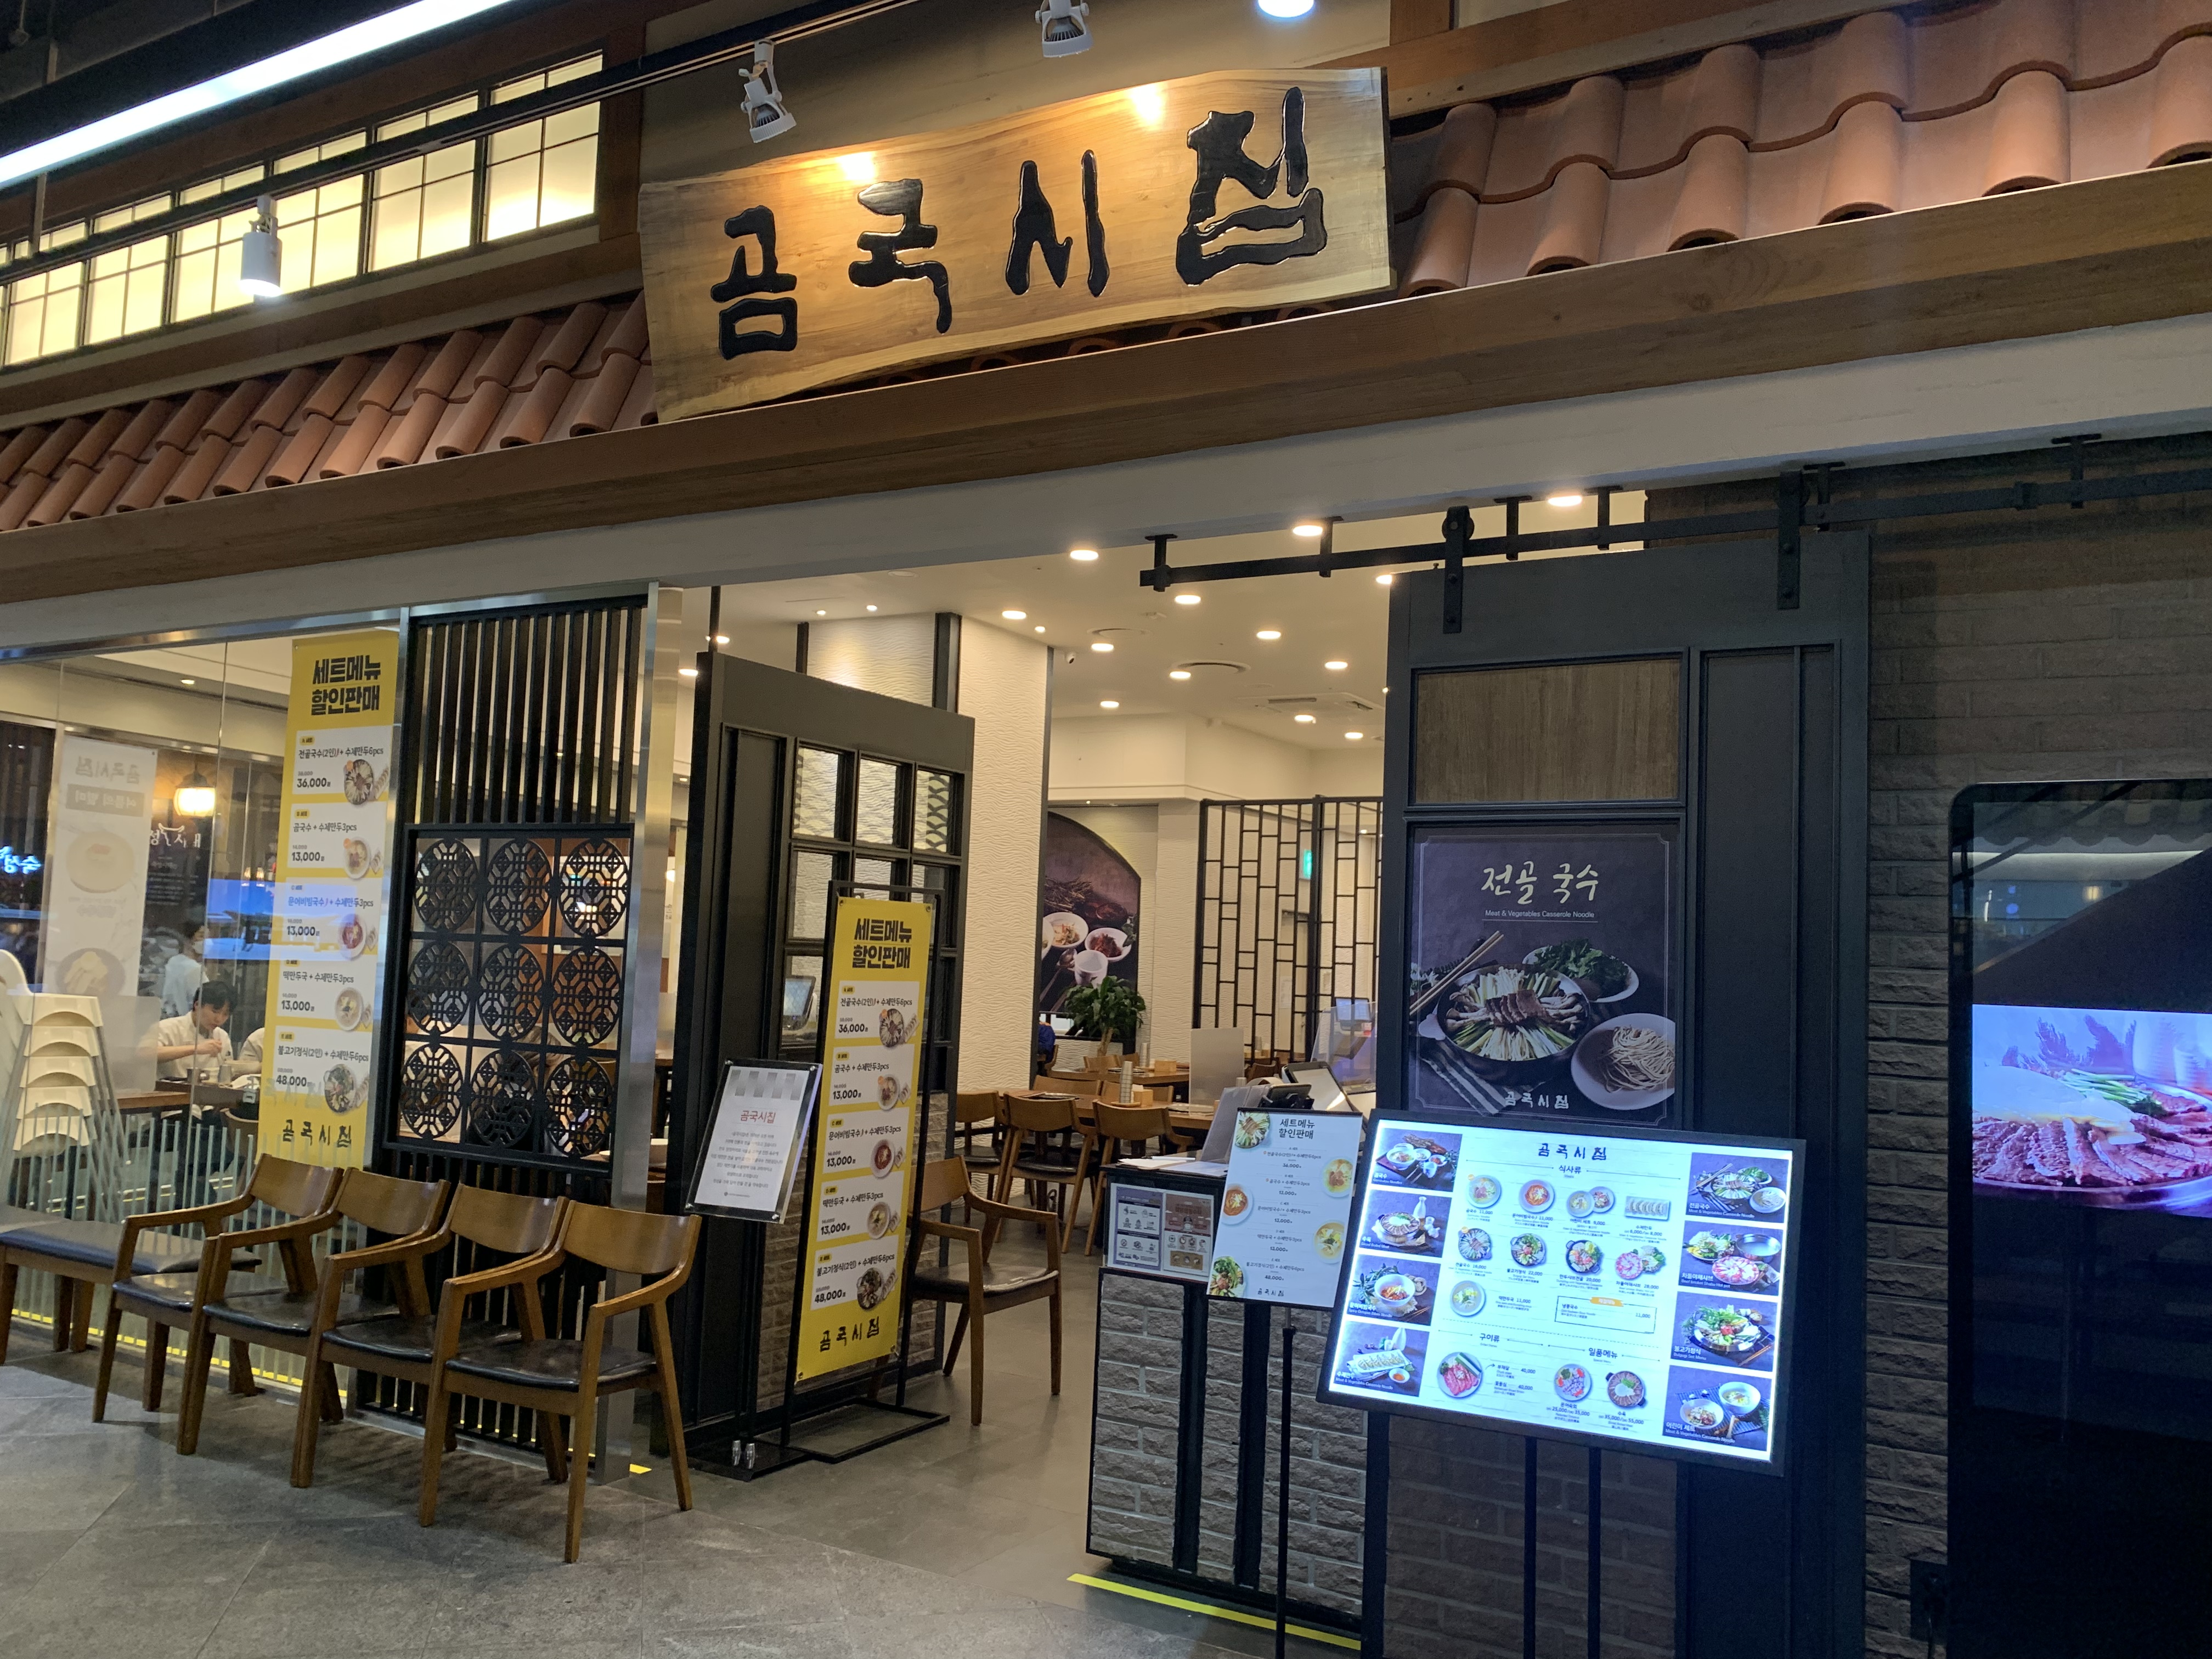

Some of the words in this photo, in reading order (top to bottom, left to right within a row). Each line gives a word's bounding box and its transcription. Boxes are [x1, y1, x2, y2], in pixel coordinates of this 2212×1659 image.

[710, 86, 1328, 361] 곰국시집
[313, 655, 381, 684] 세트메뉴
[311, 685, 380, 715] 할인판매
[293, 823, 312, 832] 곰국수
[1481, 861, 1537, 904] 전골
[1553, 861, 1599, 903] 국수
[854, 918, 912, 943] 세트메뉴
[852, 945, 911, 969] 할인판매
[1505, 1092, 1568, 1109] 곰국시집
[741, 1110, 775, 1124] 곰국시집
[1280, 1118, 1315, 1128] 세트메뉴
[283, 1119, 352, 1148] 곰국시집
[1279, 1128, 1313, 1139] 할인판매
[1538, 1143, 1606, 1160] 곰국시집
[1559, 1165, 1582, 1174] 식사류
[1257, 1288, 1284, 1297] 곰국시집
[820, 1316, 879, 1352] 곰국시집
[1480, 1333, 1499, 1342] 구이류
[1589, 1347, 1618, 1359] 일품메뉴
[1674, 1346, 1701, 1355] 불고기정식
[1666, 1422, 1683, 1430] 어린이
[1684, 1424, 1695, 1432] 세트
